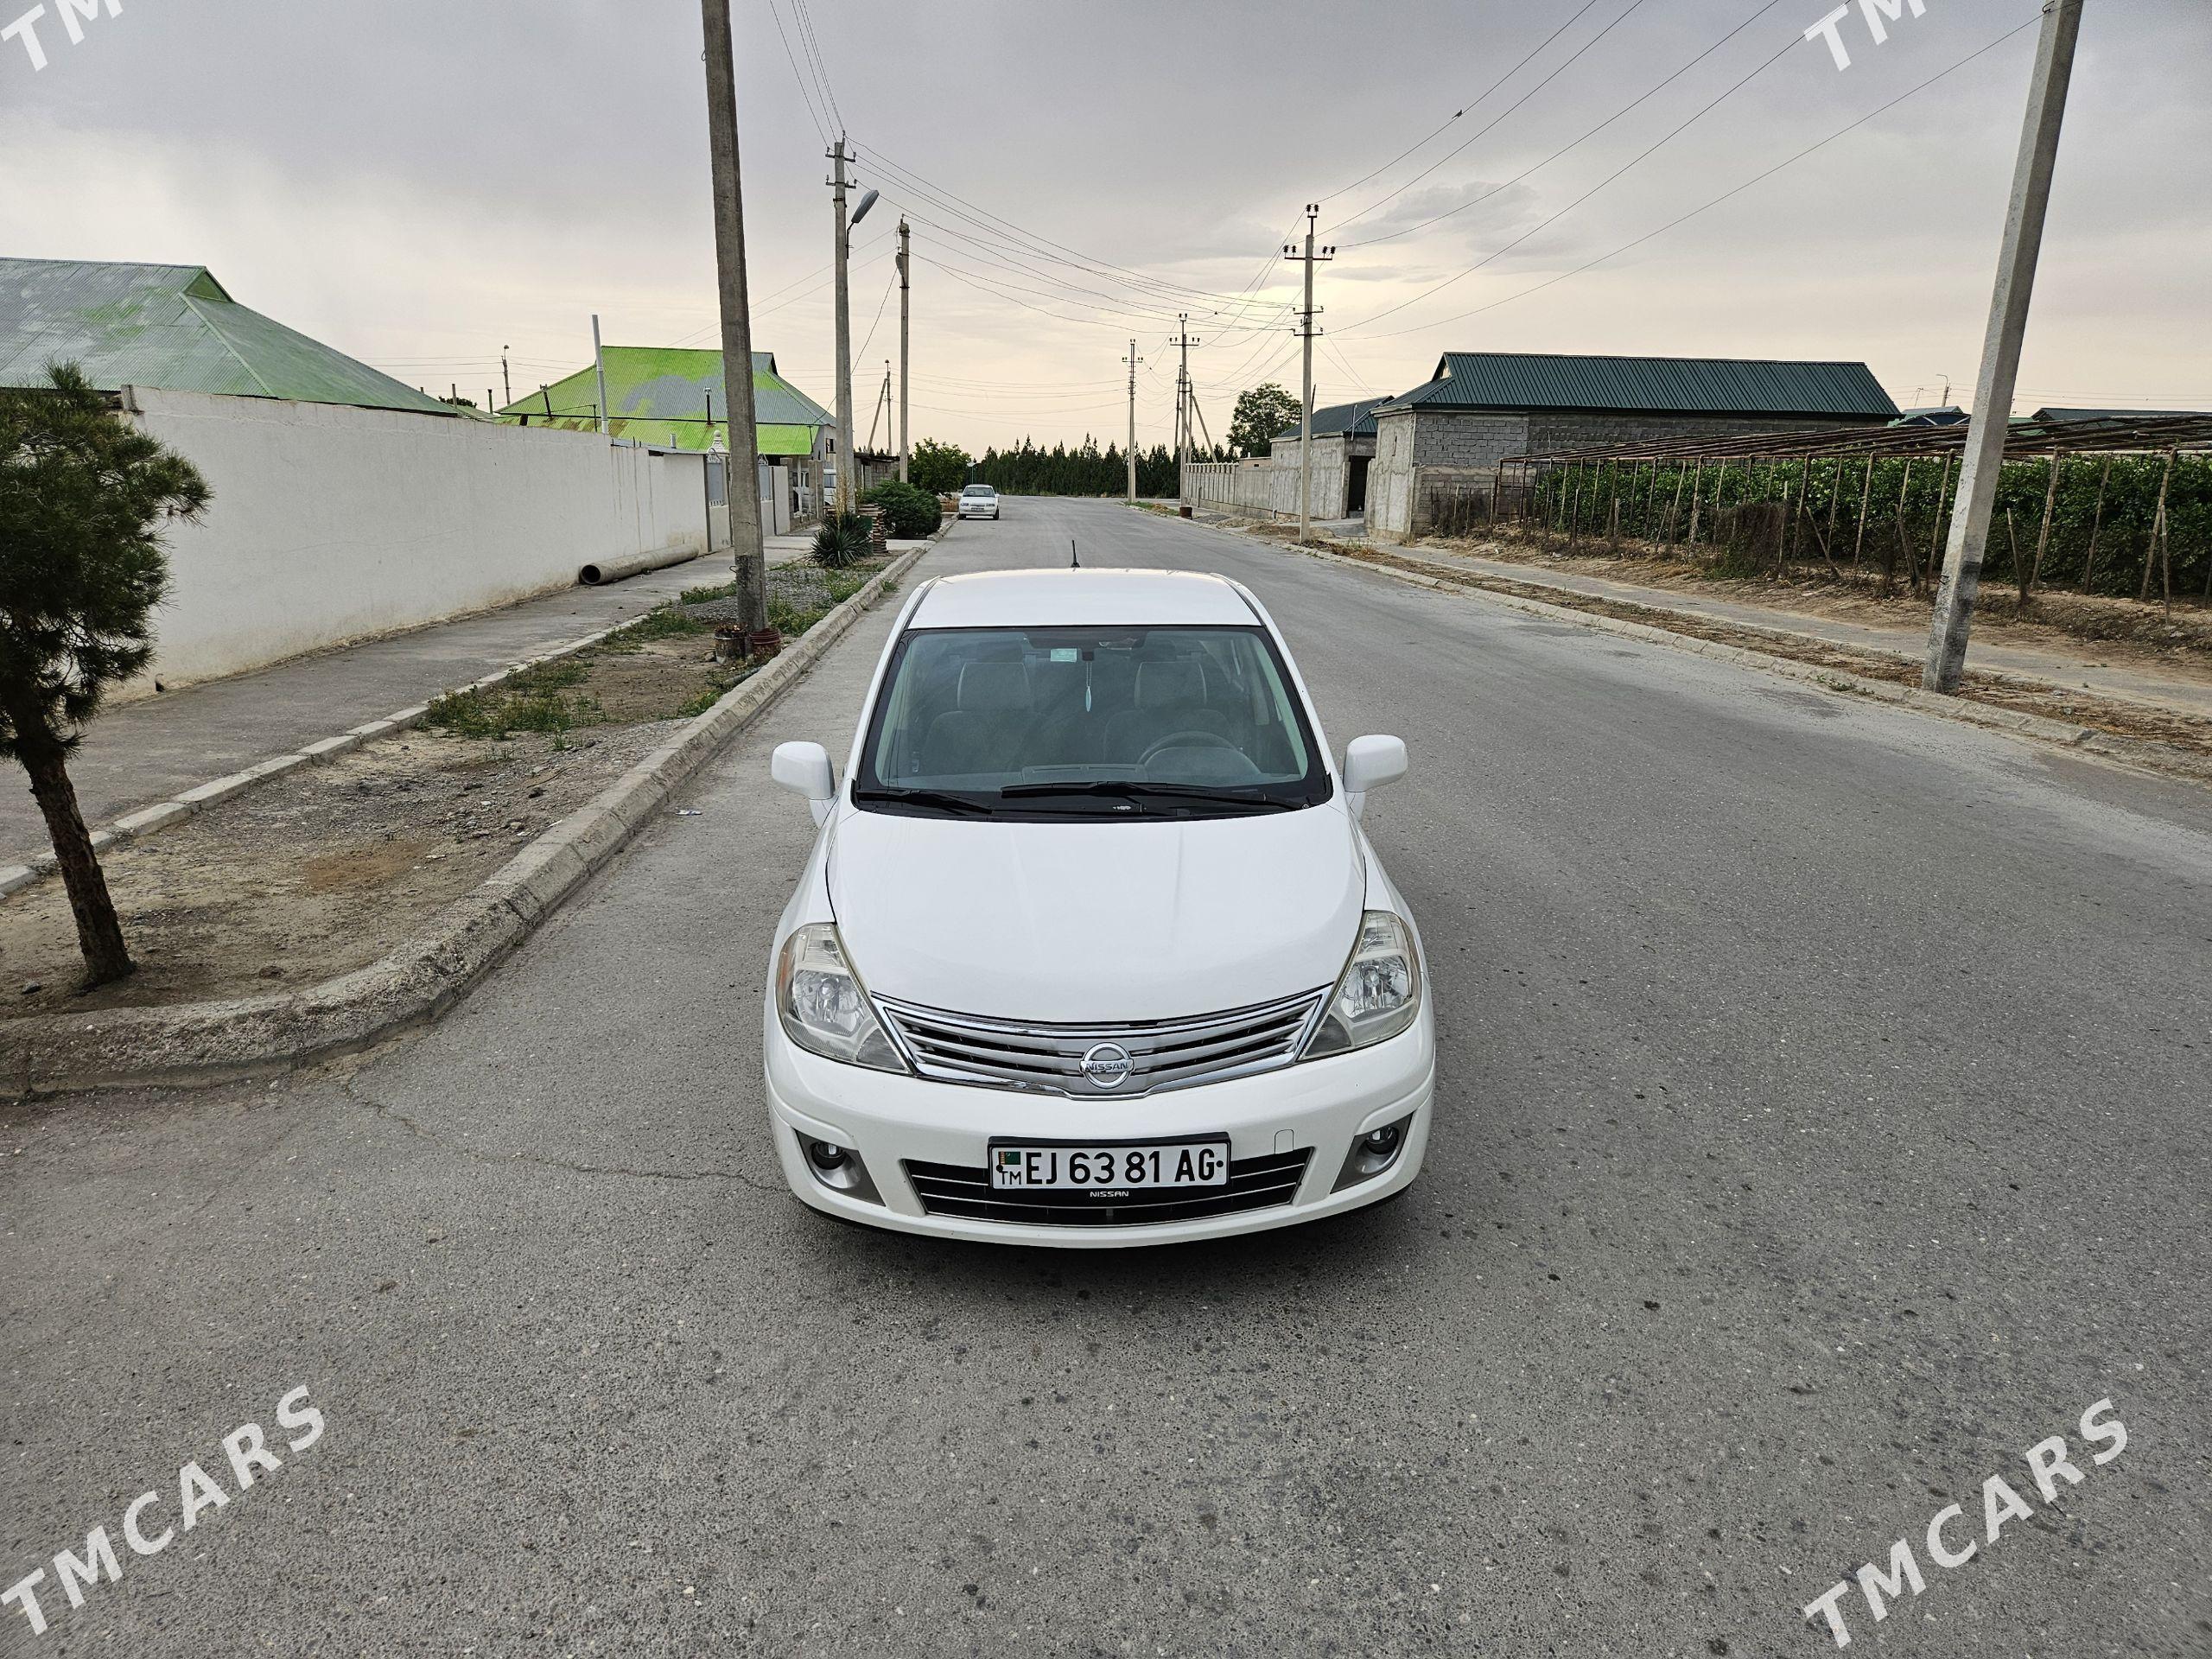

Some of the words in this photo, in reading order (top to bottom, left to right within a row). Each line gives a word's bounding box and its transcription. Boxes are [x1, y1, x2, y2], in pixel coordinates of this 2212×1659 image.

[1085, 1061, 1128, 1071] NISSAN
[999, 1170, 1021, 1185] TM
[1026, 1152, 1058, 1184] EJ
[1174, 1148, 1215, 1182] AG
